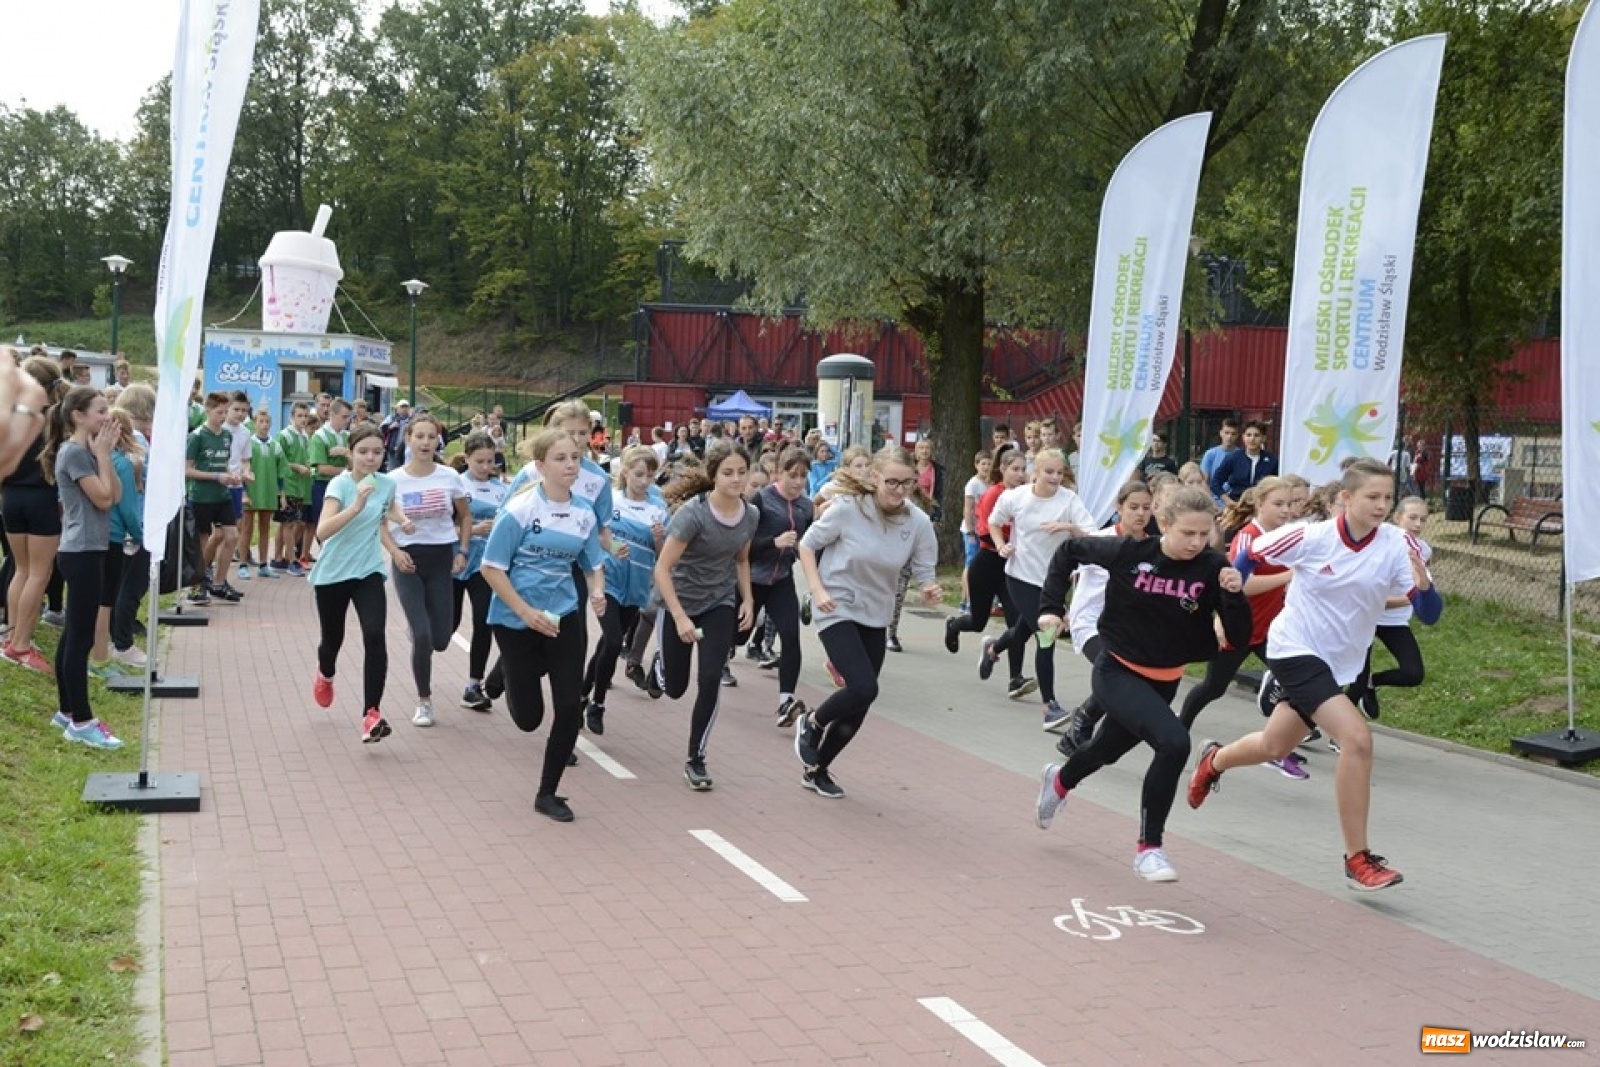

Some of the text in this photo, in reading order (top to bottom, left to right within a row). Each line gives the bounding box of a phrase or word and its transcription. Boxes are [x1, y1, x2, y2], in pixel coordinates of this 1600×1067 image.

[1128, 236, 1147, 315] REKREACJI
[1340, 186, 1367, 280] REKREACJI
[1107, 254, 1130, 390] MIEJSKI OŚRODEK
[1315, 206, 1344, 371] MIEJSKI OŚRODEK
[1353, 278, 1375, 370] CENTRUM
[1374, 254, 1397, 371] Wodzisław Śląski
[218, 362, 274, 387] Lody
[1120, 329, 1137, 390] SPORTU
[1134, 315, 1154, 390] CENTRUM
[1151, 294, 1170, 391] Wodzisław Śląski
[1333, 298, 1352, 371] SPORTU
[533, 518, 542, 534] 6
